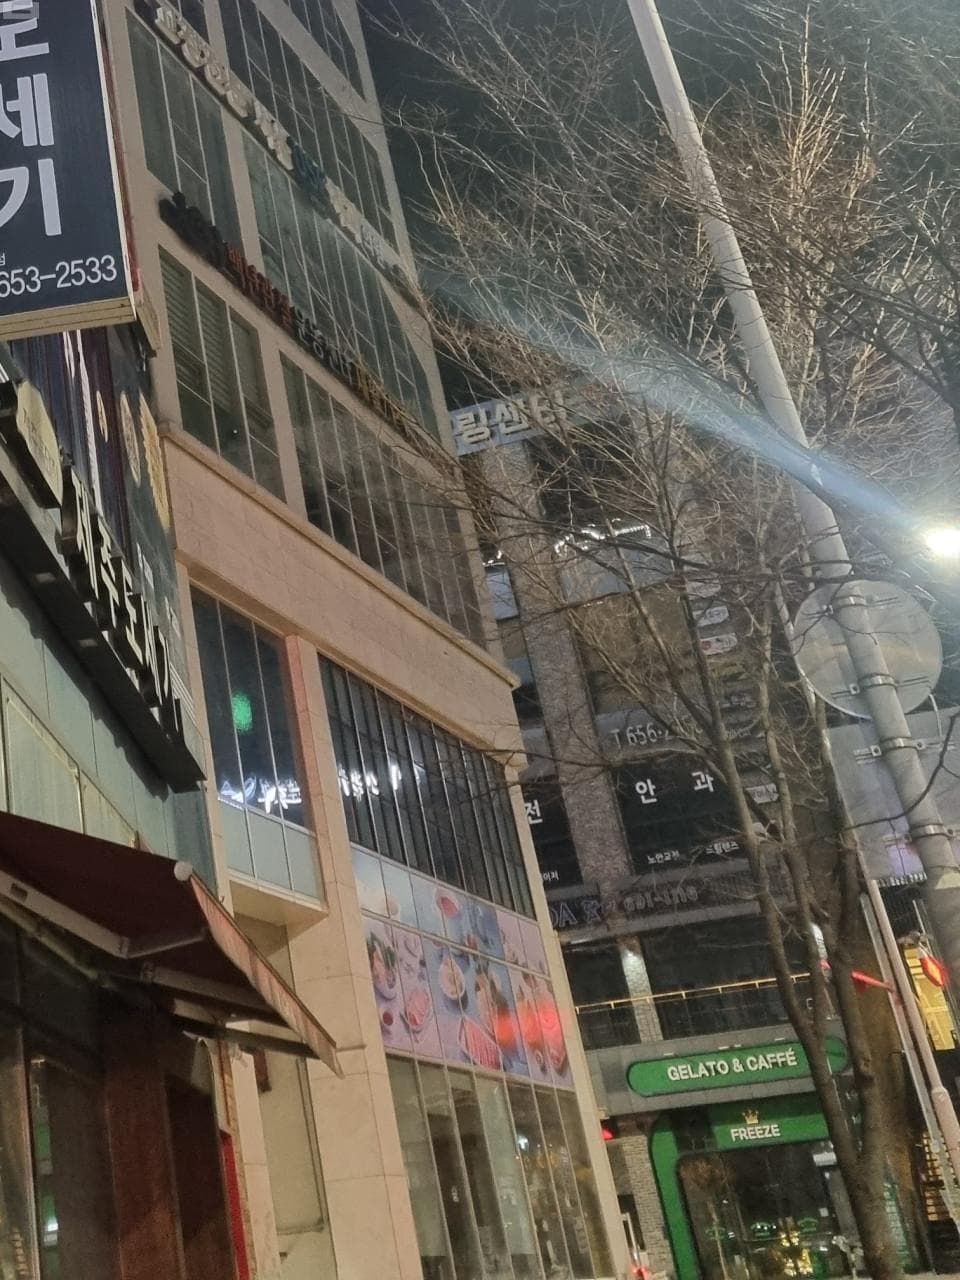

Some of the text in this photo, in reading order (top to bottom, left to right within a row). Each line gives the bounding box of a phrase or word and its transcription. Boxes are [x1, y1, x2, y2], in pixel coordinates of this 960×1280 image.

[667, 1046, 798, 1082] GELATO & CAFFÉ
[729, 1123, 782, 1142] FREEZE
